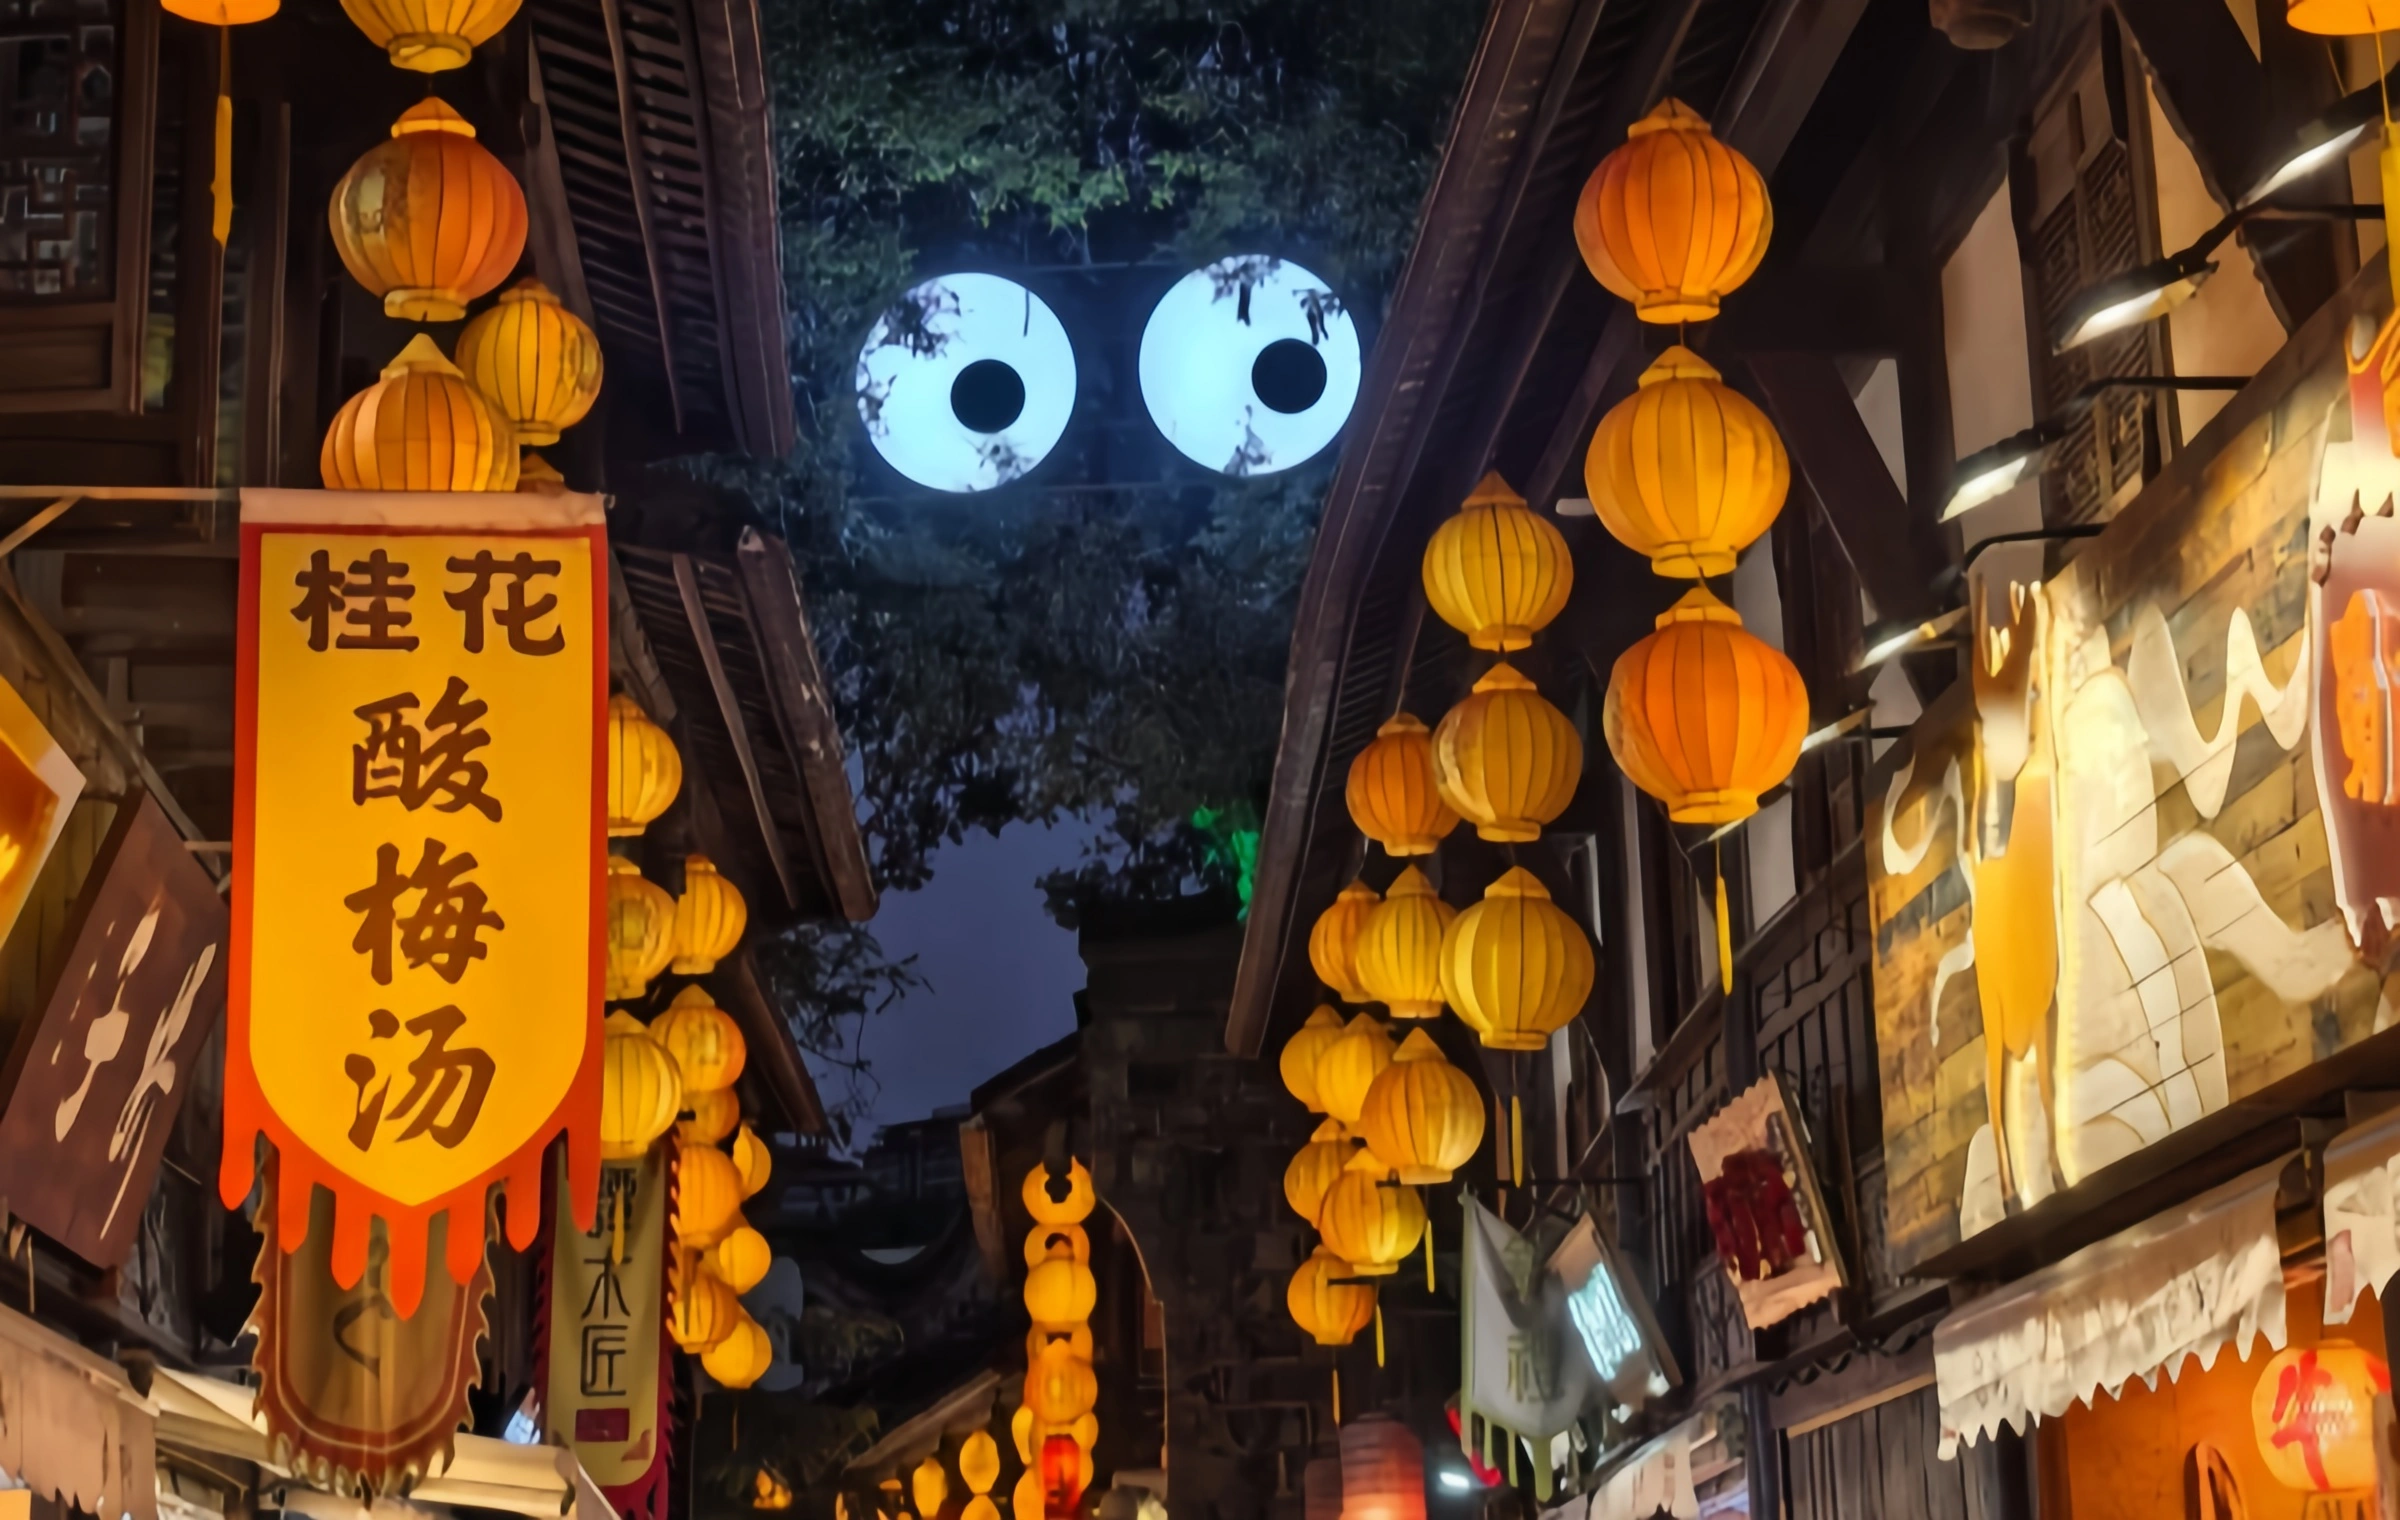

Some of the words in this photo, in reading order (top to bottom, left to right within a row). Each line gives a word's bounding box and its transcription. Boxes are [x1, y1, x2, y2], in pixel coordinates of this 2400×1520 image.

[290, 549, 565, 656] 桂花
[344, 676, 504, 1151] 酸梅汤
